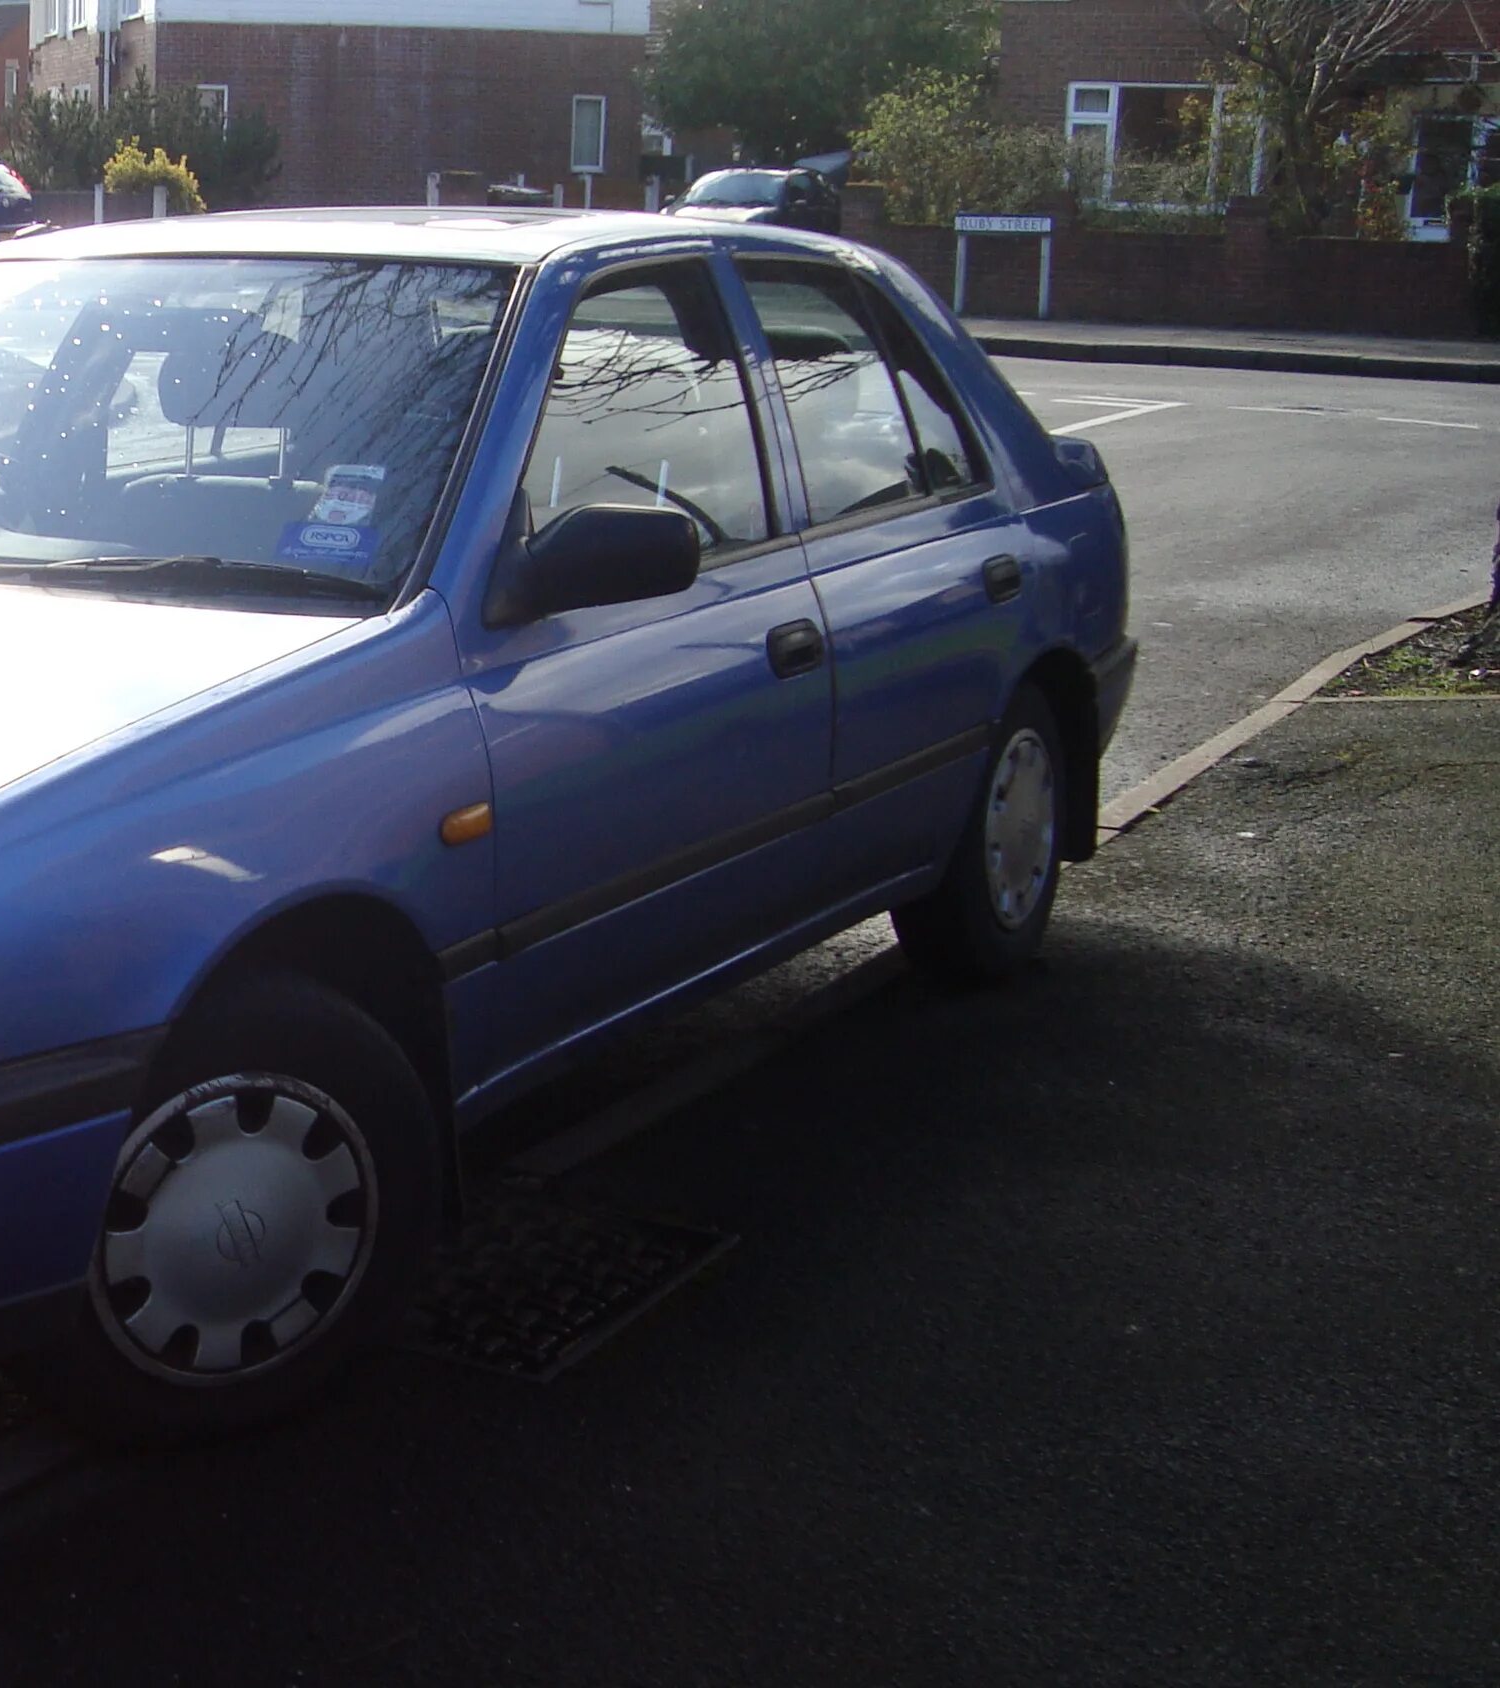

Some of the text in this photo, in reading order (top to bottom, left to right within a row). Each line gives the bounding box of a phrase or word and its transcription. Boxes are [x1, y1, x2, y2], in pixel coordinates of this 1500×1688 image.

[961, 218, 1043, 230] RUBY STREET
[309, 531, 349, 543] RSPCA
